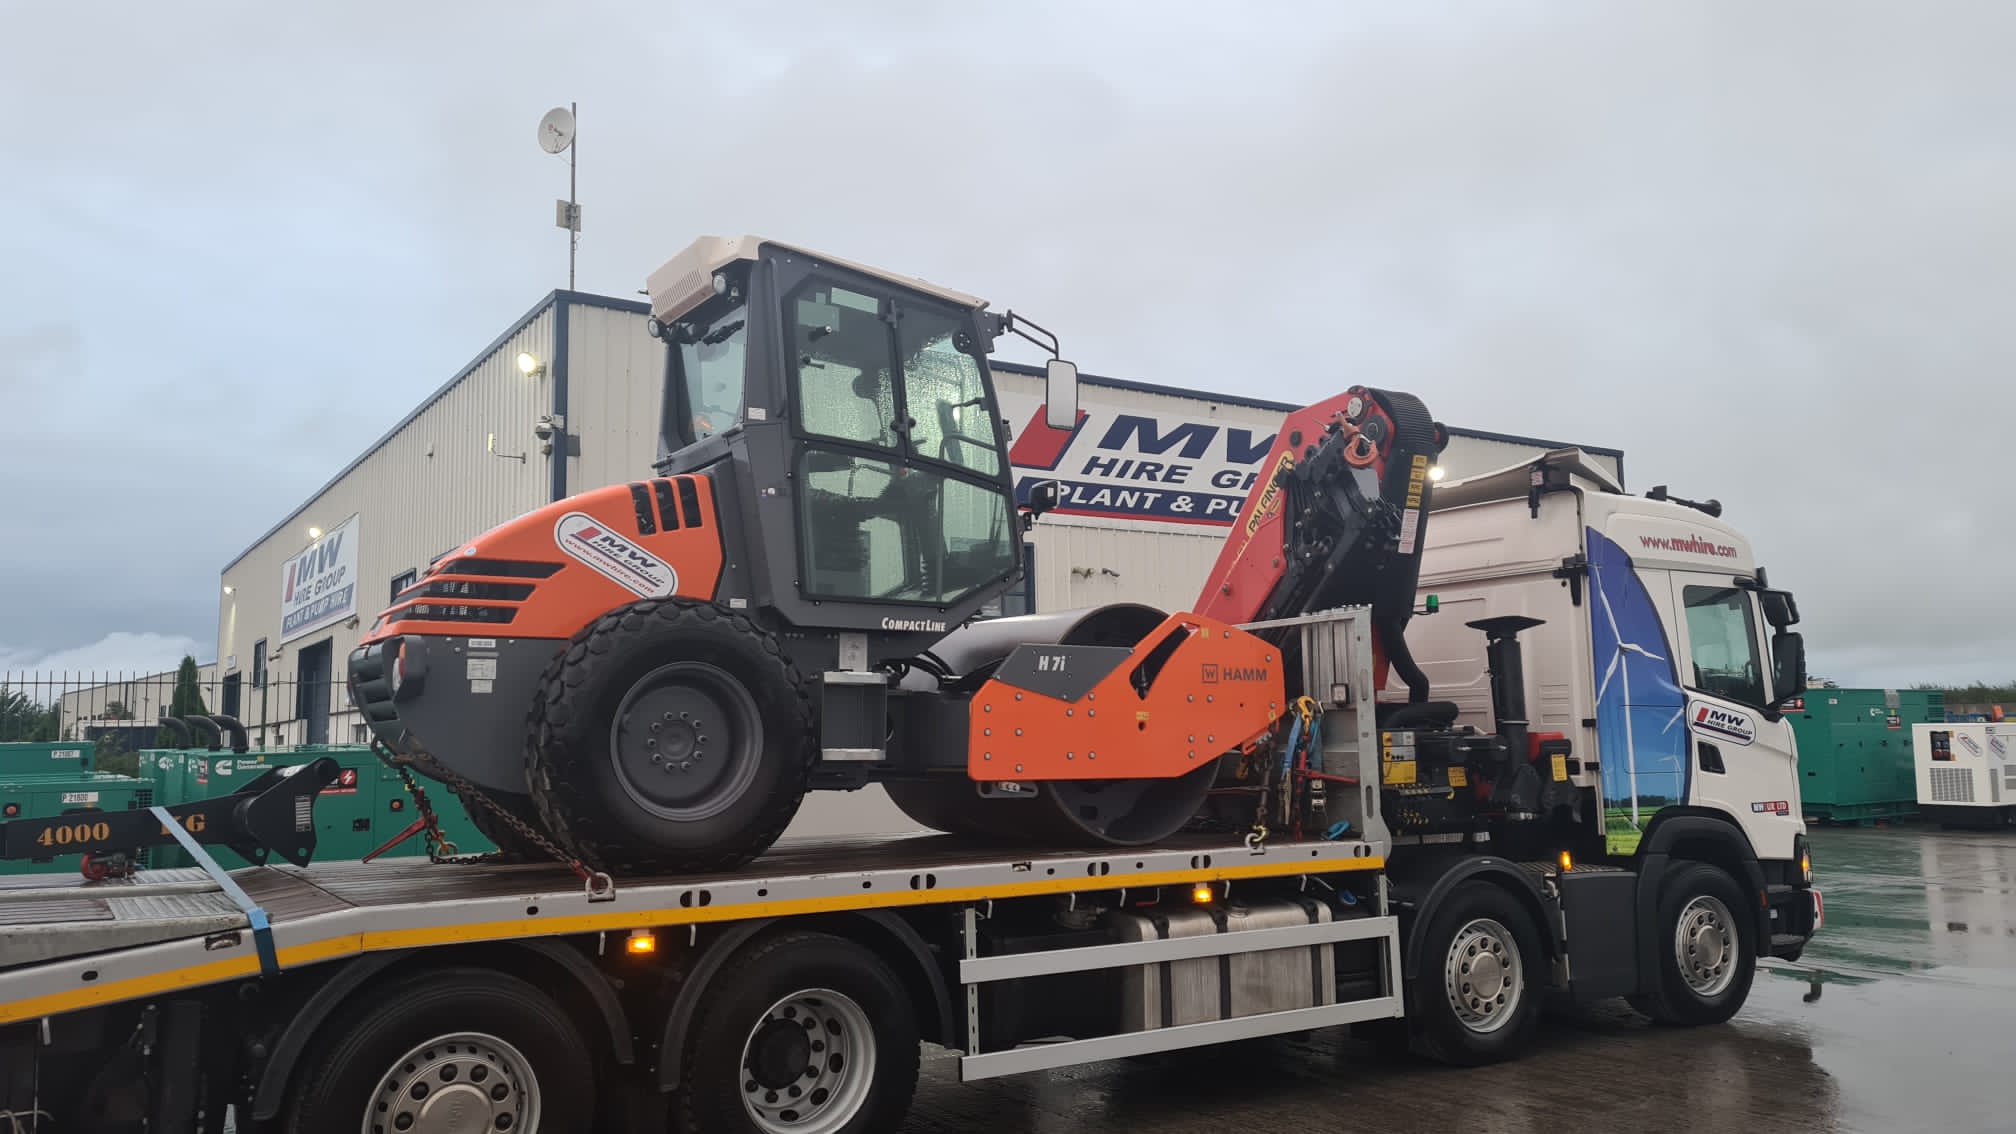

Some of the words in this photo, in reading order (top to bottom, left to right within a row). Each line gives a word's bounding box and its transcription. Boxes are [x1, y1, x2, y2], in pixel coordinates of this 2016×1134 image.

[1080, 456, 1193, 485] HIRE
[1169, 495, 1195, 512] &
[600, 535, 658, 569] MW
[1640, 534, 1737, 558] www.mwhire.com
[296, 530, 345, 587] MW
[565, 538, 655, 594] www.mwhire.com
[592, 541, 622, 560] HIRE
[623, 558, 665, 585] GROUP
[294, 585, 312, 606] HIRE
[314, 565, 346, 595] GROUP
[1038, 656, 1050, 671] H
[1052, 656, 1066, 671] 7i
[1223, 668, 1268, 681] HAMM
[1707, 719, 1726, 729] HIRE
[1727, 725, 1753, 736] GROUP
[1710, 710, 1745, 727] MW
[37, 822, 110, 846] 4000
